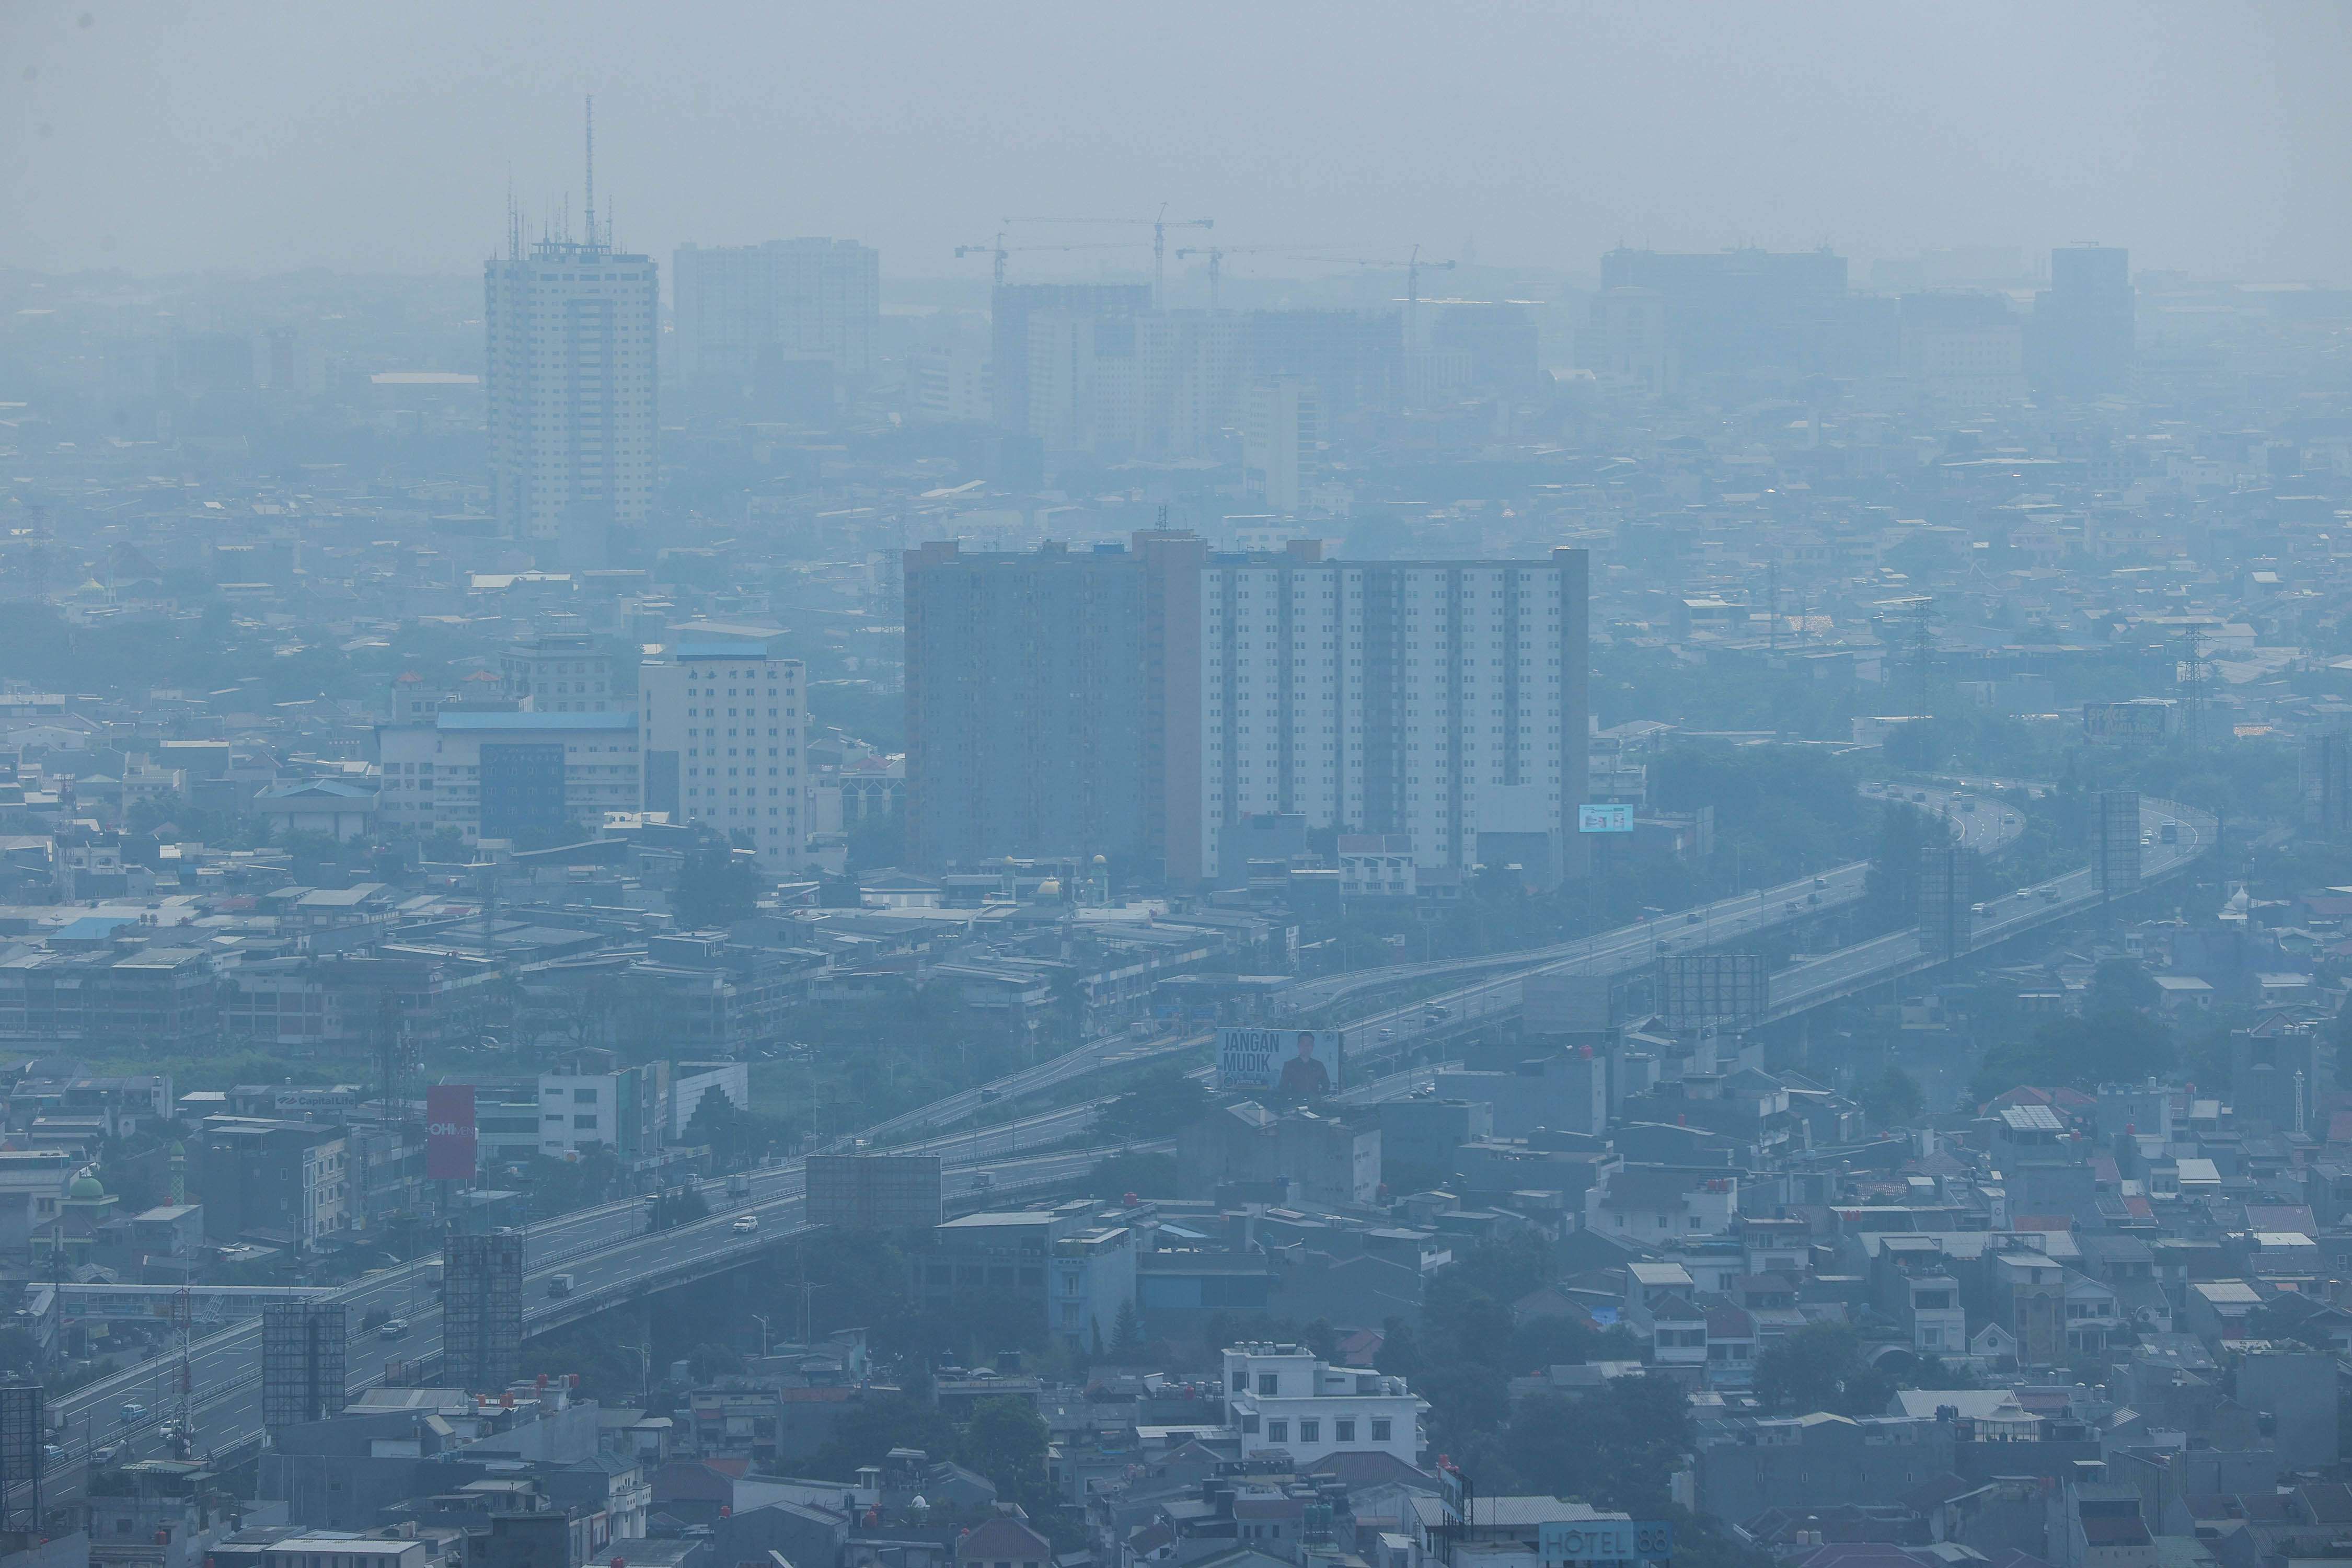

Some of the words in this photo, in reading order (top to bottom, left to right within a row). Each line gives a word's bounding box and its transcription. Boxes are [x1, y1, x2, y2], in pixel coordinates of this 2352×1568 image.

[2088, 708, 2128, 721] SPACE
[1223, 1032, 1279, 1052] JANGAN
[1223, 1053, 1271, 1073] MUDIK
[1639, 1529, 1667, 1552] 88
